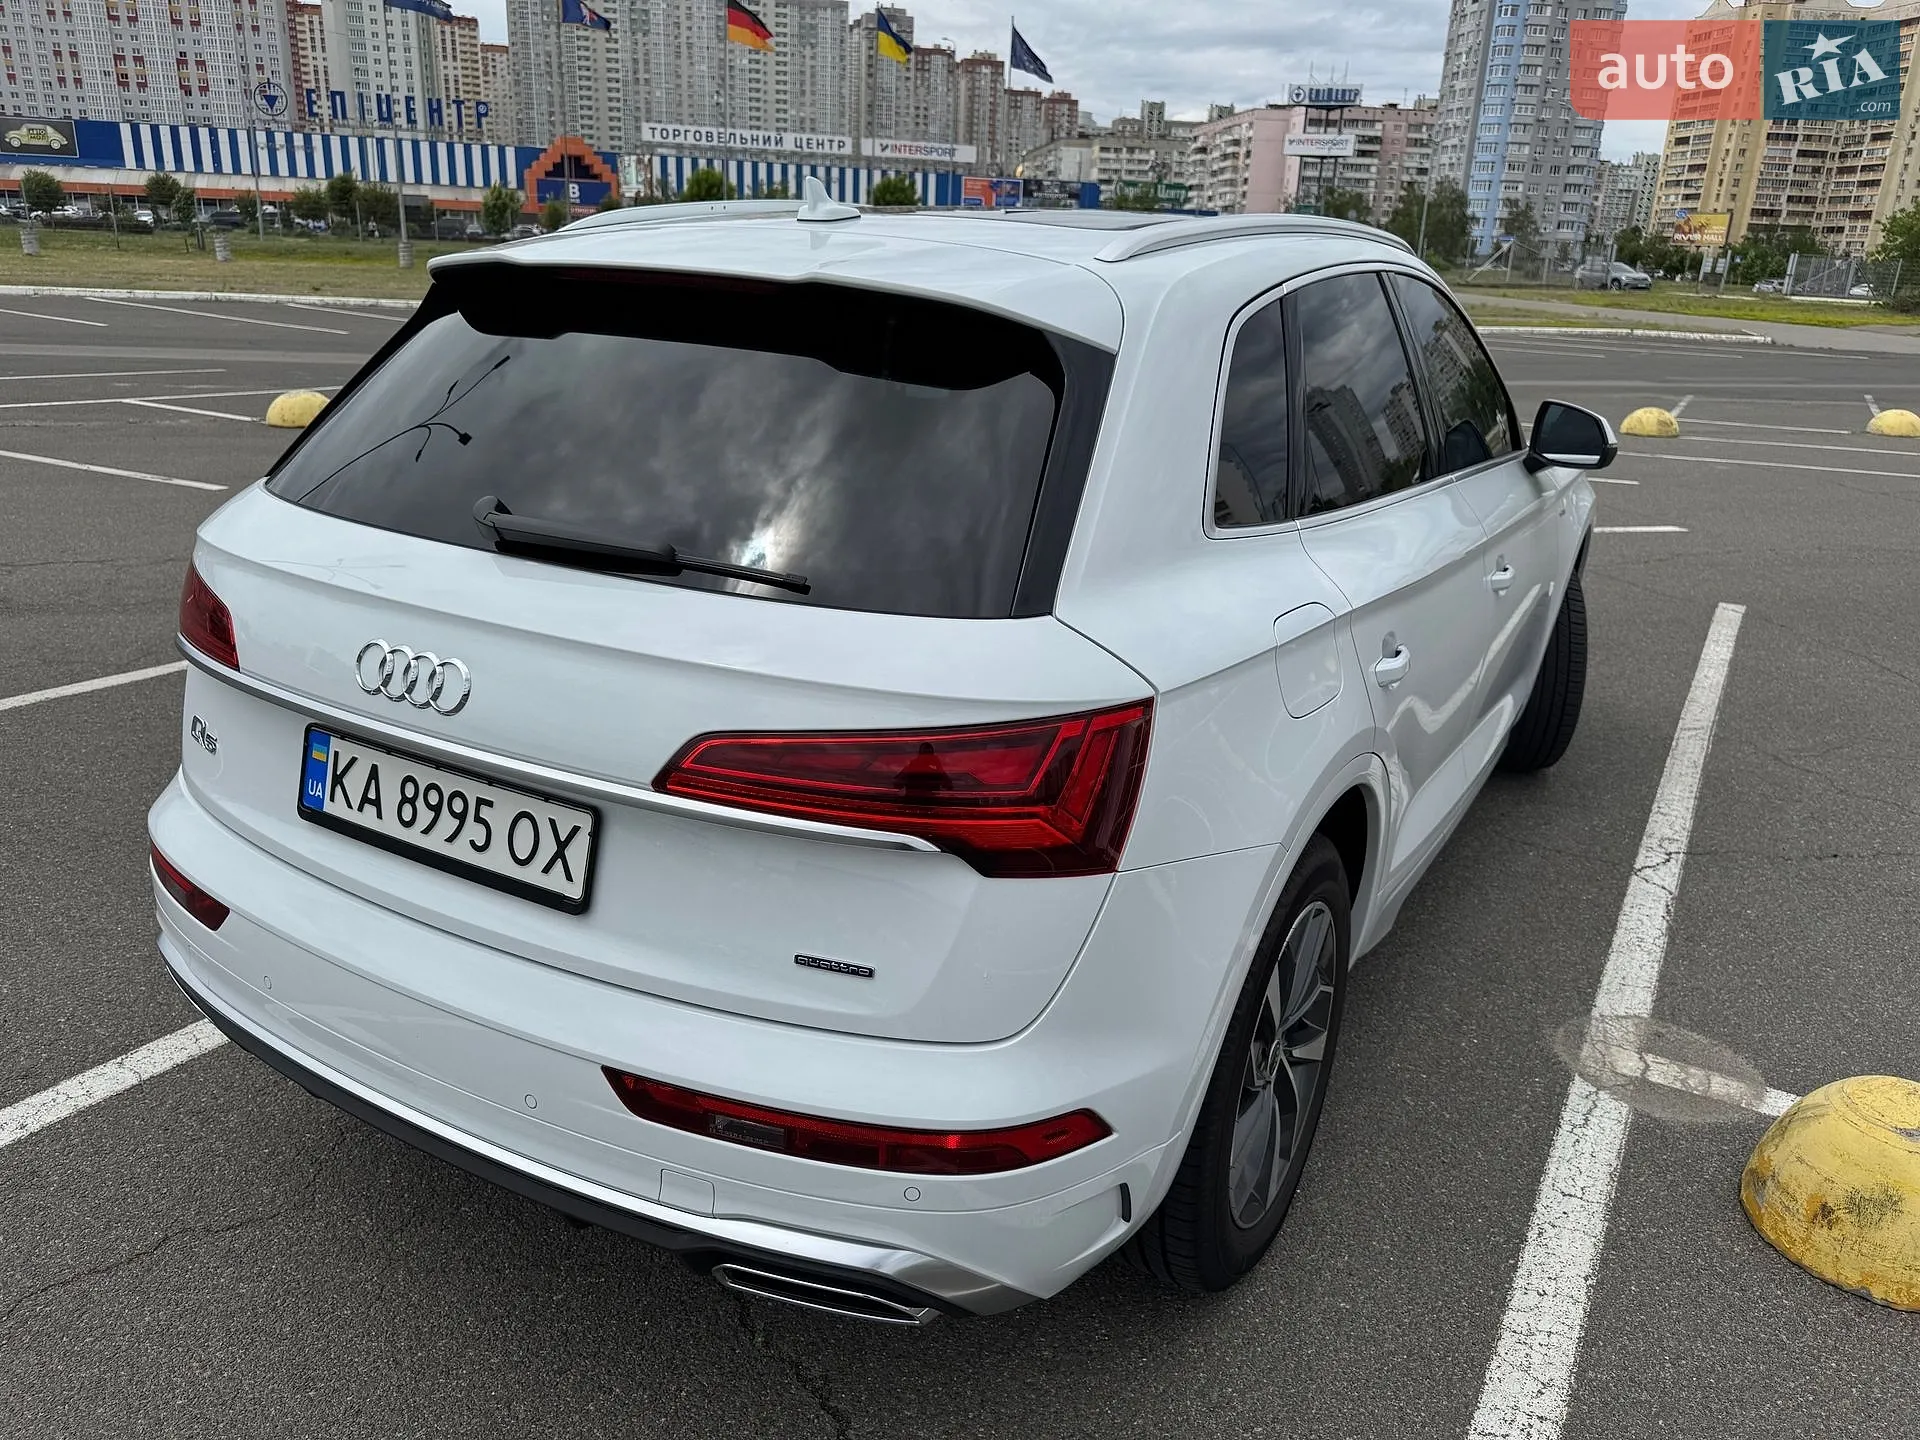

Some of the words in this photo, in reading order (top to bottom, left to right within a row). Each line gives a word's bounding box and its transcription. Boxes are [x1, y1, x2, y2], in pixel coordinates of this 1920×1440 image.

[305, 88, 489, 129] ЕПІЦЕНТР
[649, 126, 784, 148] ТОРГОВЕЛЬНИЙ
[794, 136, 846, 151] ЦЕНТР
[891, 143, 957, 157] INTERSPORT
[308, 779, 323, 798] UA
[329, 750, 383, 820] KA
[397, 774, 494, 853] 8995
[508, 810, 581, 883] OX
[797, 956, 870, 976] quattro
